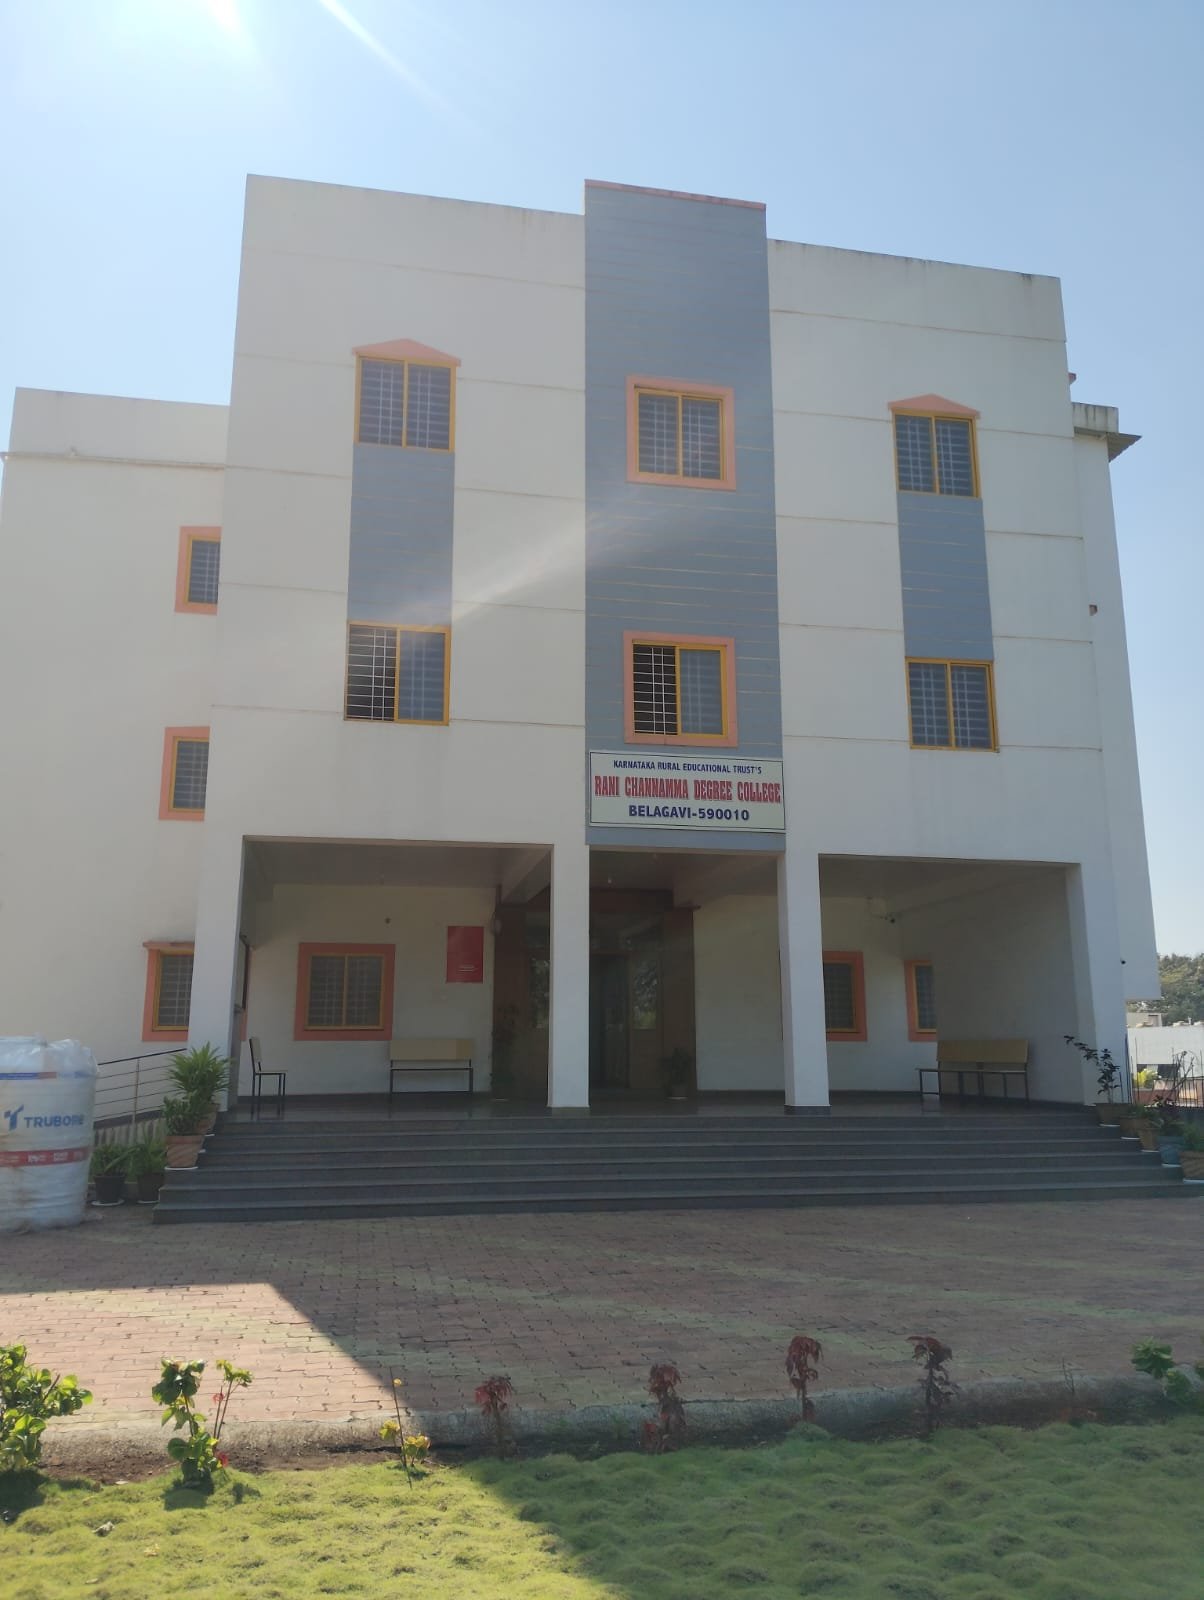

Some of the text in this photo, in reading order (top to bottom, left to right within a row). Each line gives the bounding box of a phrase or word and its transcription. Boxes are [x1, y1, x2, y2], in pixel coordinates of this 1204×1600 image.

[613, 759, 762, 774] KARNATAKA RURAL EDUCATIONAL TRUST'S
[594, 775, 781, 803] RANI CHANNAMMA DEGREE COLLEGE
[628, 804, 749, 820] BELAGAVI-590010
